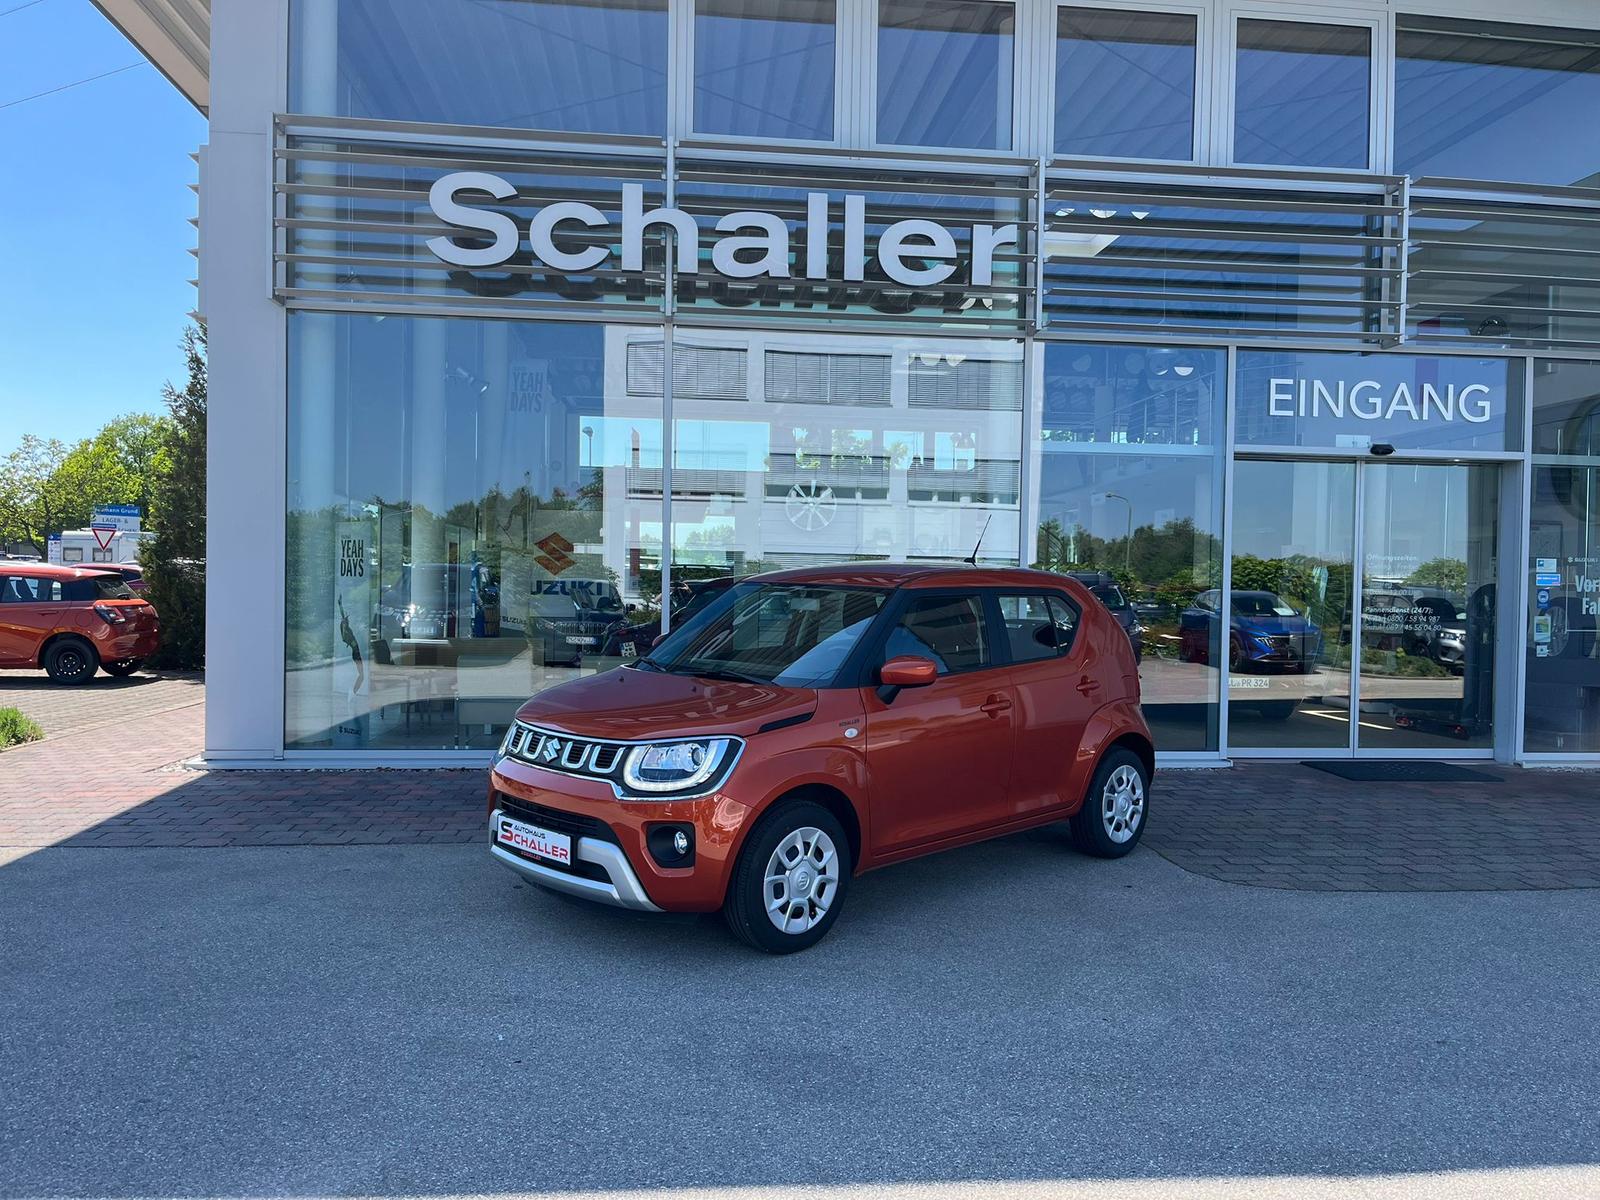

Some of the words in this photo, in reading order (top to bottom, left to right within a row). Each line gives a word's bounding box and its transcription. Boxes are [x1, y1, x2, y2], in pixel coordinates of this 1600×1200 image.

[425, 171, 1017, 287] Schaller
[1269, 378, 1491, 423] EINGANG
[341, 539, 364, 558] YEAH
[340, 558, 364, 577] DAYS
[1253, 679, 1268, 687] 324
[500, 820, 569, 860] SCHALLER
[513, 824, 546, 840] AUTOHAUS
